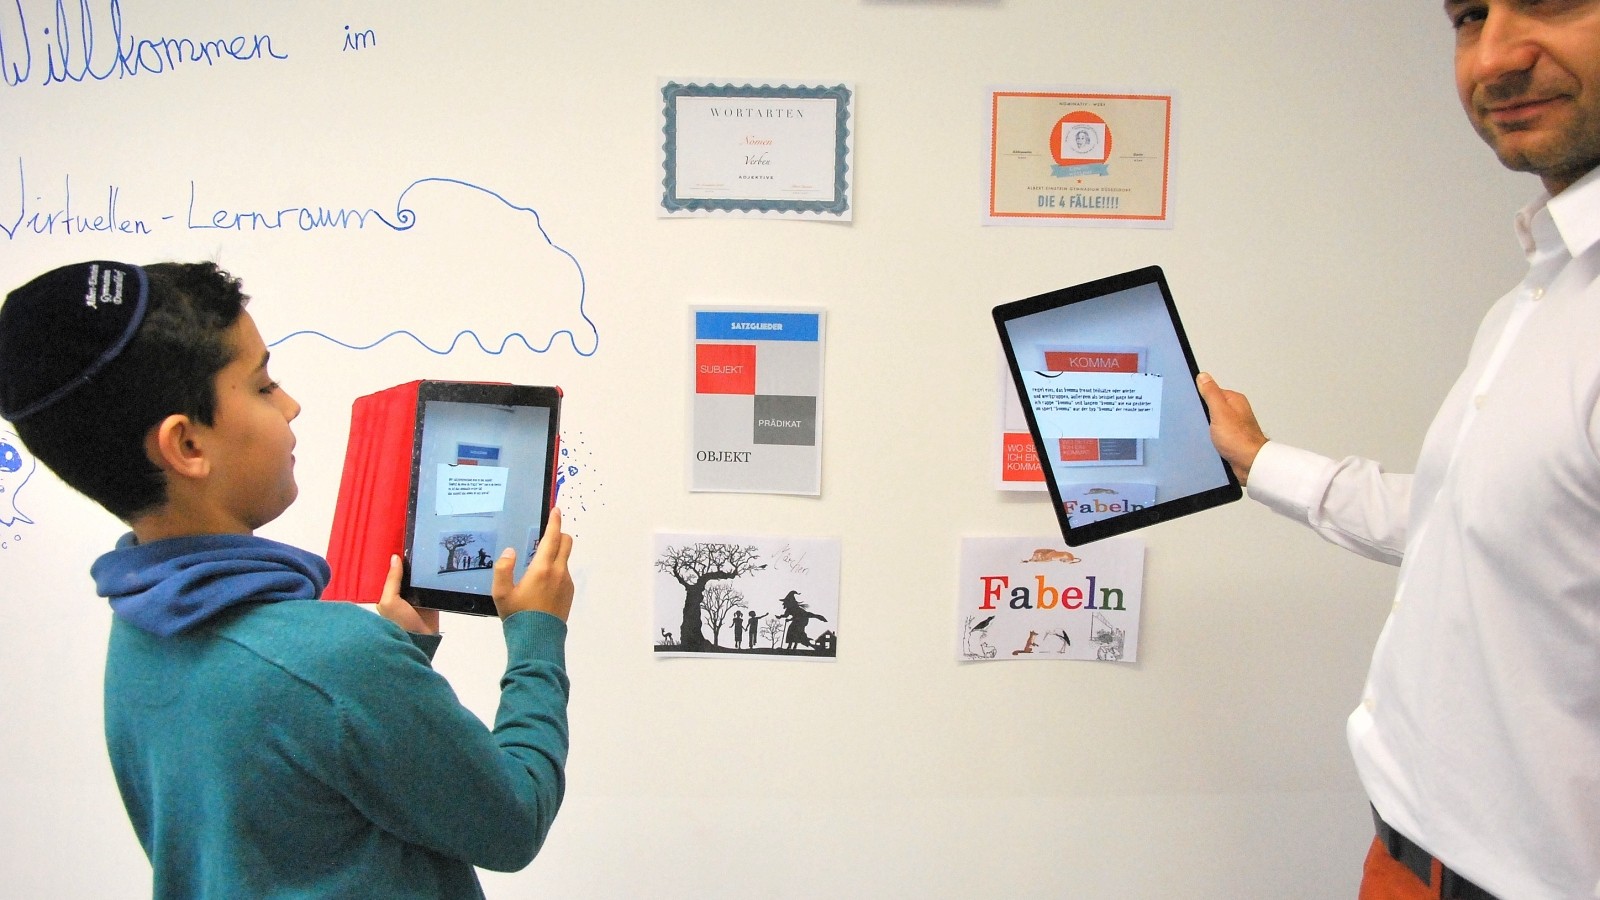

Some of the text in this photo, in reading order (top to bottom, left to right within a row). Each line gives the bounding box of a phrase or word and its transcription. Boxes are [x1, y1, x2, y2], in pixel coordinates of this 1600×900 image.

[0, 0, 376, 86] Willkommen im
[710, 107, 804, 118] WORTARTEN
[739, 135, 773, 146] Nomen
[744, 151, 771, 166] Verben
[1038, 193, 1119, 208] DIE 4 FÄLLE!!!!
[731, 322, 783, 331] SATZGLIEDER
[1069, 357, 1120, 368] KOMMA
[700, 365, 744, 374] SUBJEKT
[758, 418, 802, 428] PRÄDIKAT
[1007, 444, 1037, 453] WO SE
[696, 450, 752, 463] OBJEKT
[1007, 453, 1023, 461] ICH
[978, 575, 1127, 611] Fabeln
